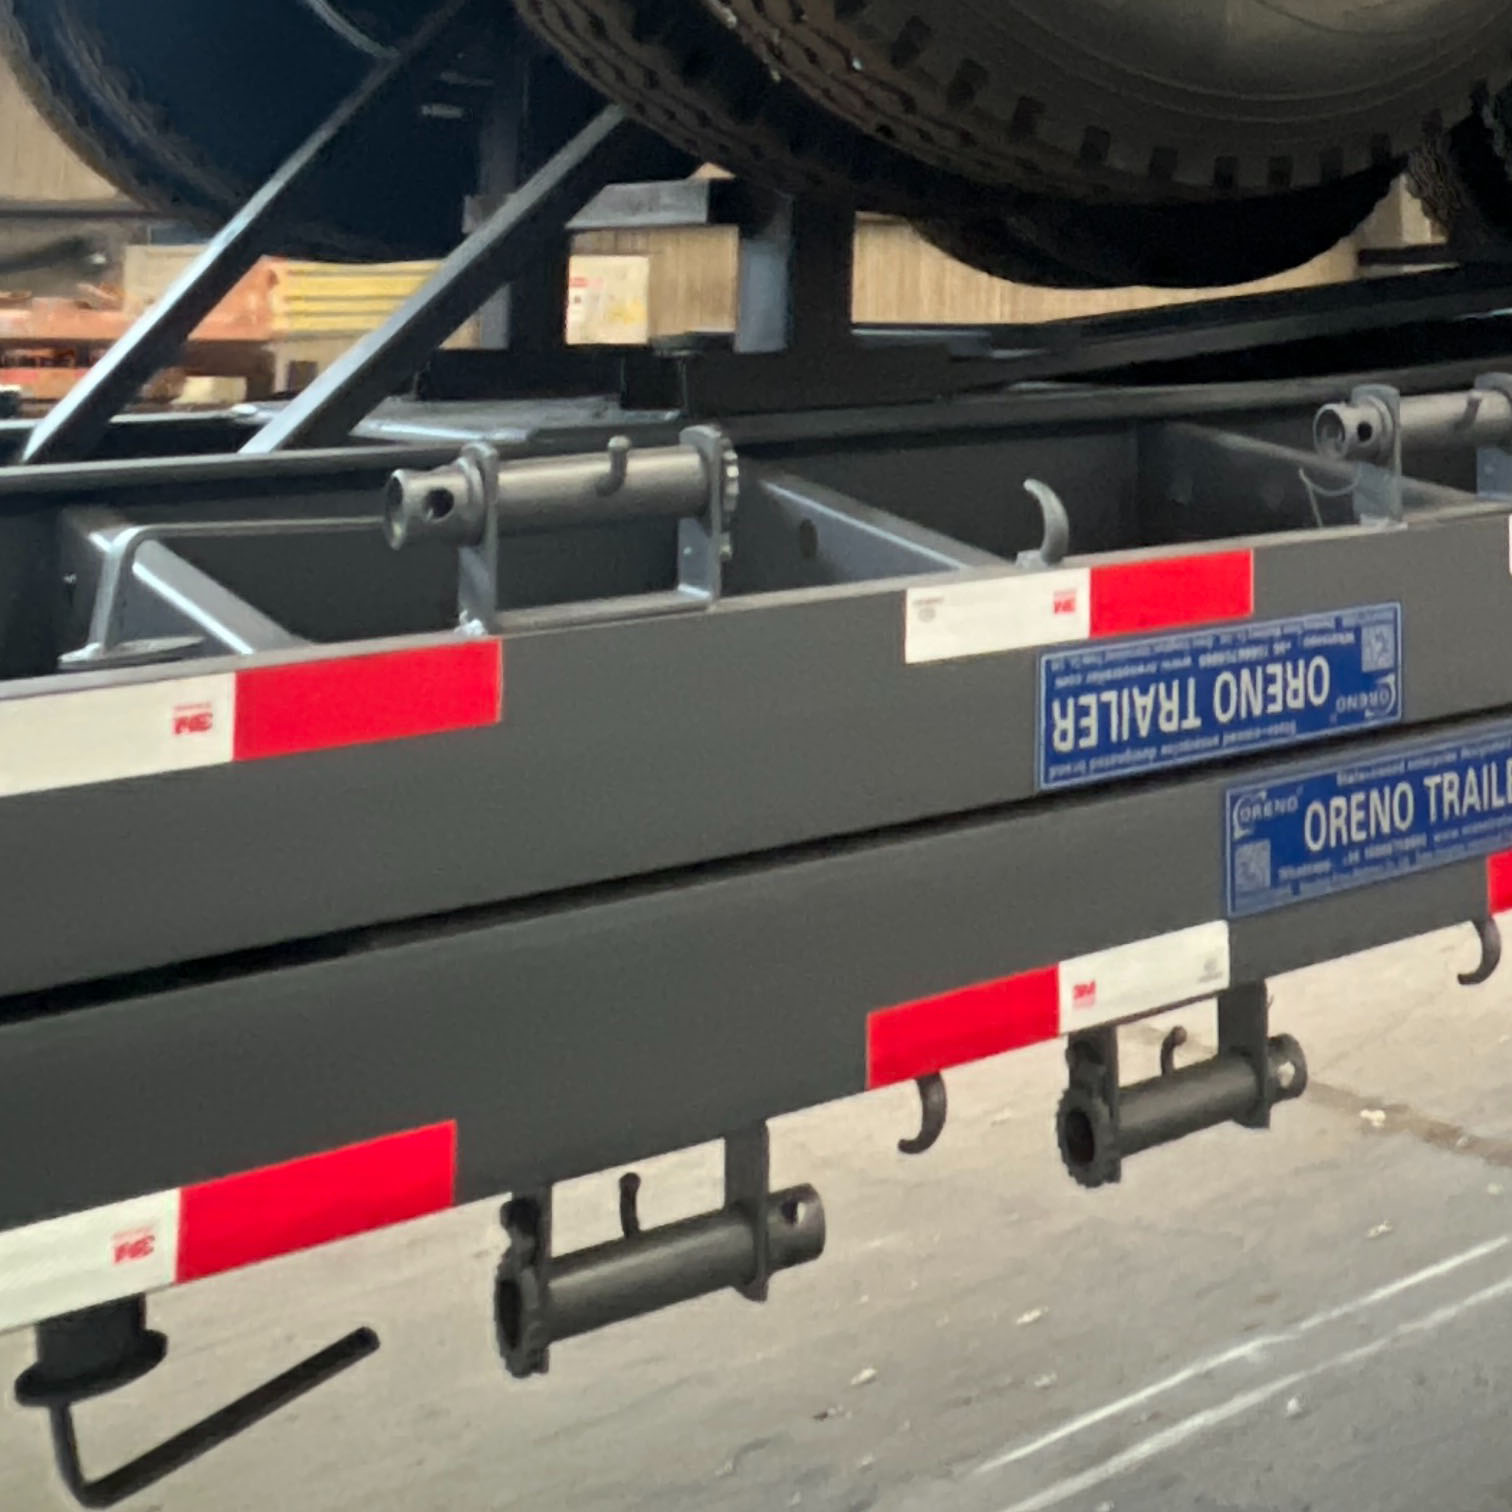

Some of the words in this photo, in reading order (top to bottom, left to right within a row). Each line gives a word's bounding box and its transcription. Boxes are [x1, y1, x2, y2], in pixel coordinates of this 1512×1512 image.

[1052, 674, 1201, 756] TRAILER
[1213, 653, 1330, 725] ORENO
[1304, 778, 1414, 854] ORENO
